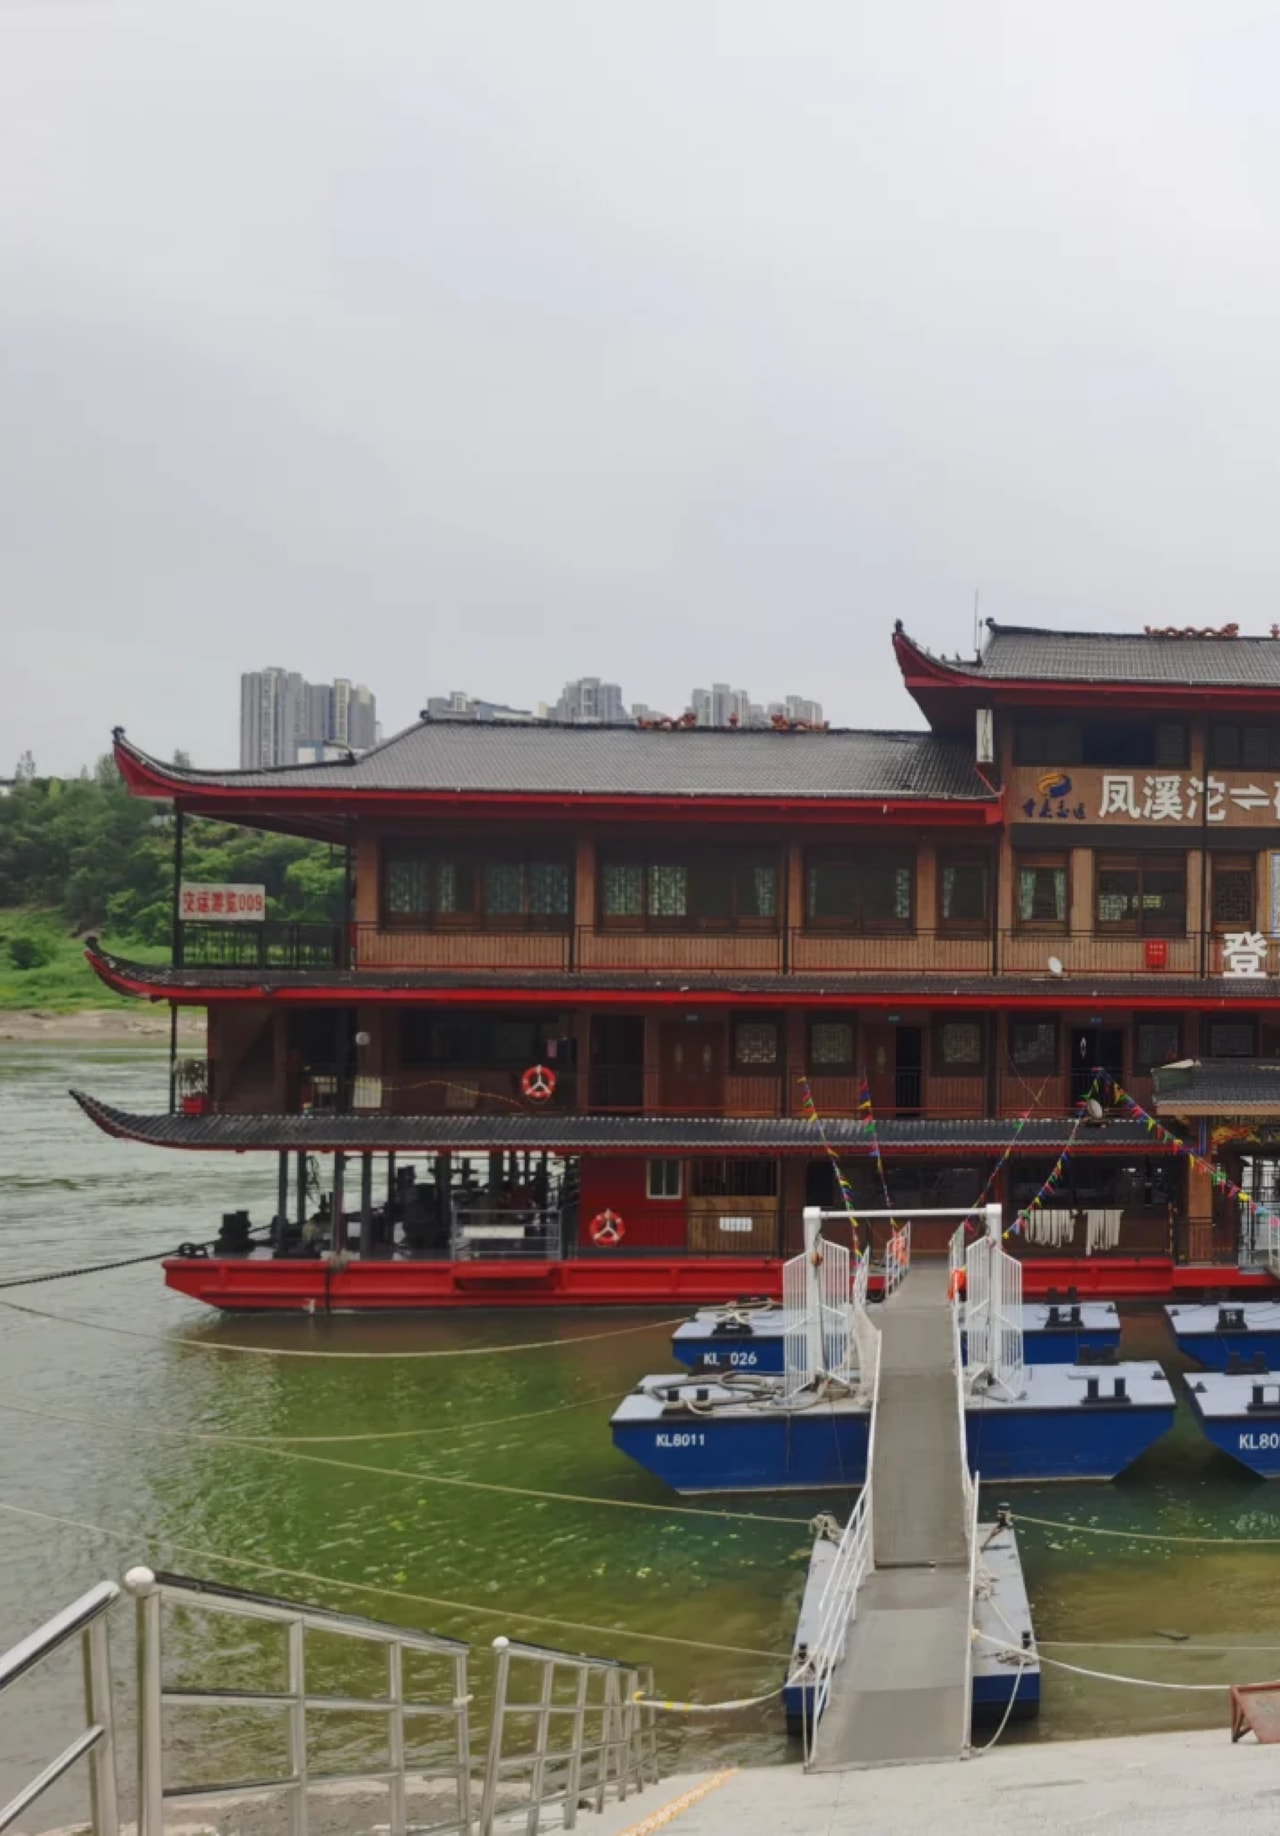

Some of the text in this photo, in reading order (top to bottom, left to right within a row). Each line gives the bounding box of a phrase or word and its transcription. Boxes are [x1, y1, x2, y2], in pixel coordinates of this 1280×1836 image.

[1099, 774, 1226, 822] 凤溪沱
[655, 1433, 705, 1448] KL8011
